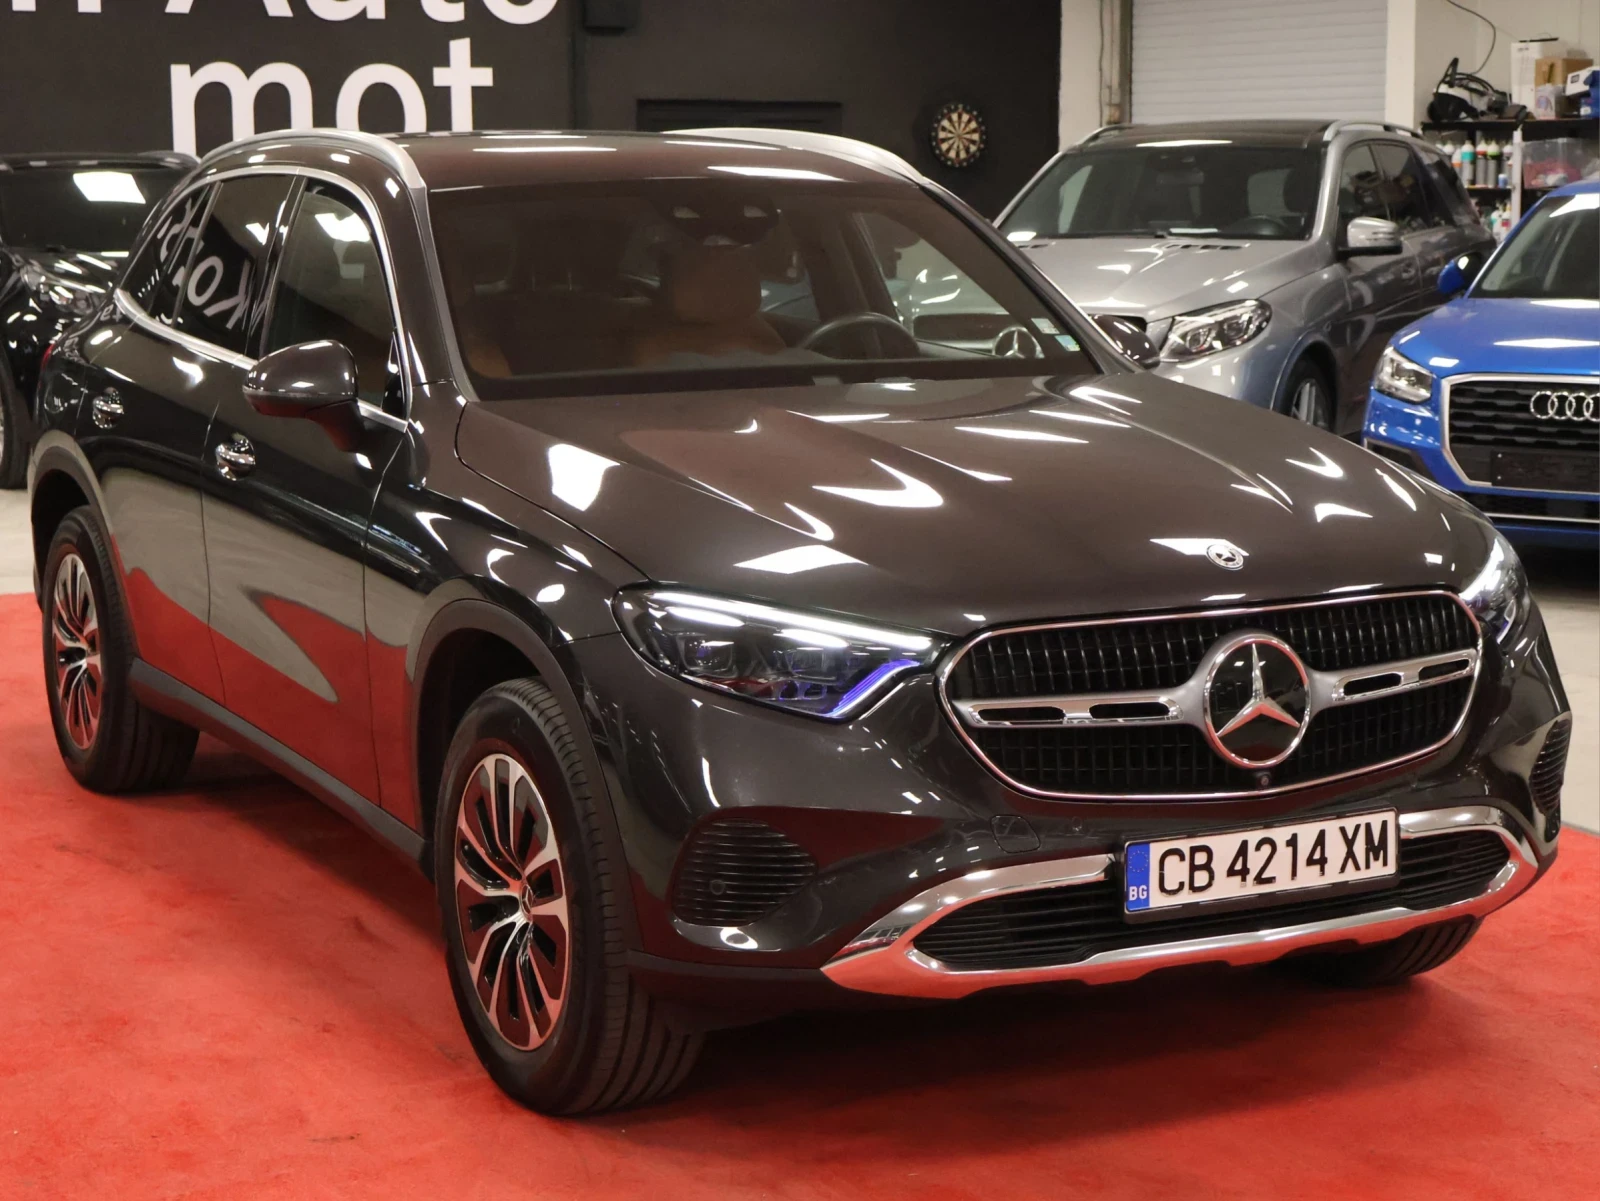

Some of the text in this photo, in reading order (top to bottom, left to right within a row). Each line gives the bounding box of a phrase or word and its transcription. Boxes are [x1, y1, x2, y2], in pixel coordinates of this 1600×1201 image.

[170, 37, 494, 162] mot
[1129, 884, 1148, 901] BG
[1158, 819, 1389, 896] CB 4214 XM
